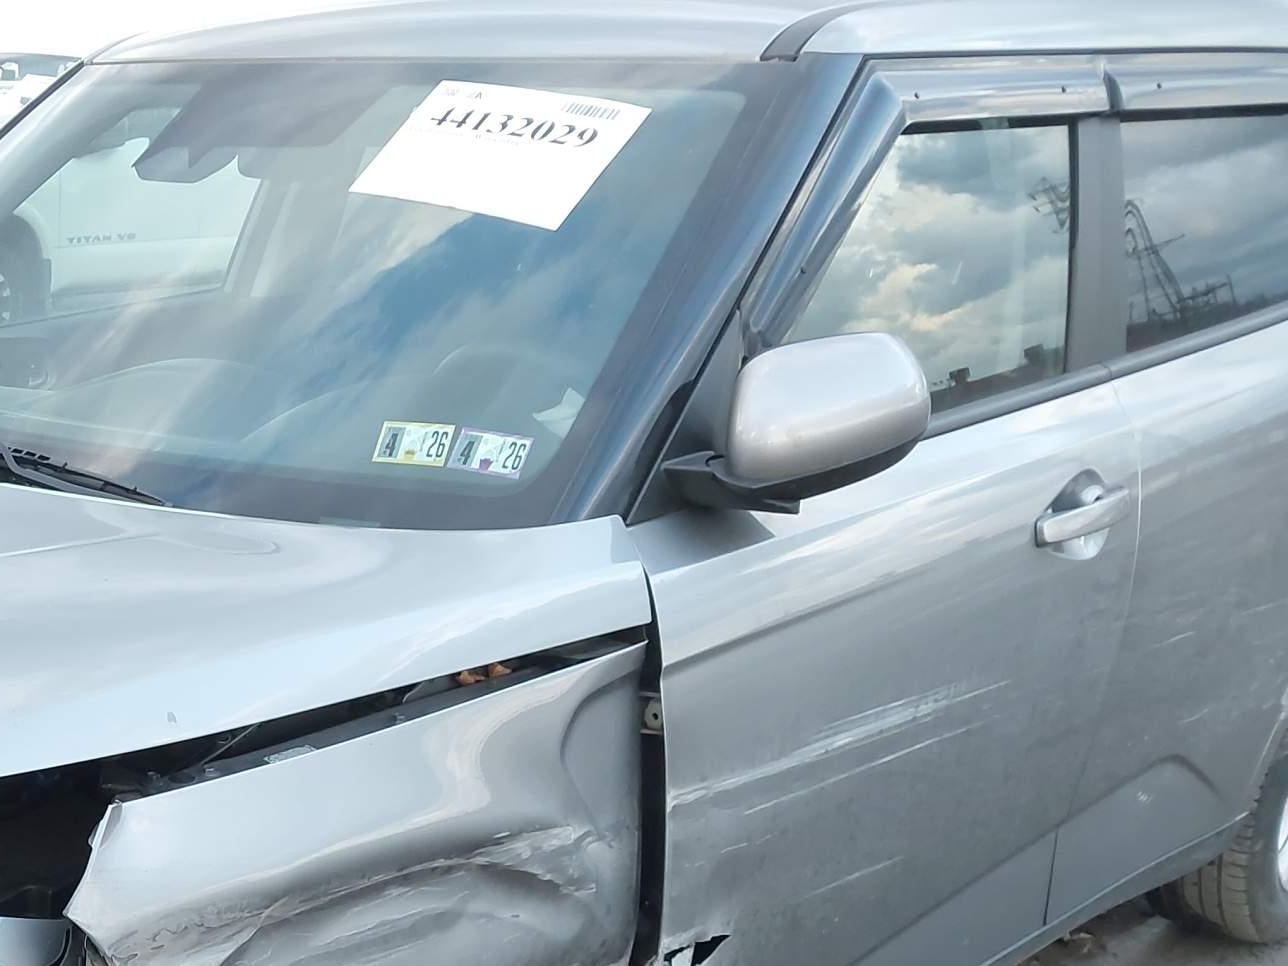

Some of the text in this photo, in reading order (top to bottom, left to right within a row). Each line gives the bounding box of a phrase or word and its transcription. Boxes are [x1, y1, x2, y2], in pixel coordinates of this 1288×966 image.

[430, 106, 598, 148] 44132029
[385, 430, 449, 458] 4 26
[459, 440, 527, 471] 4 26
